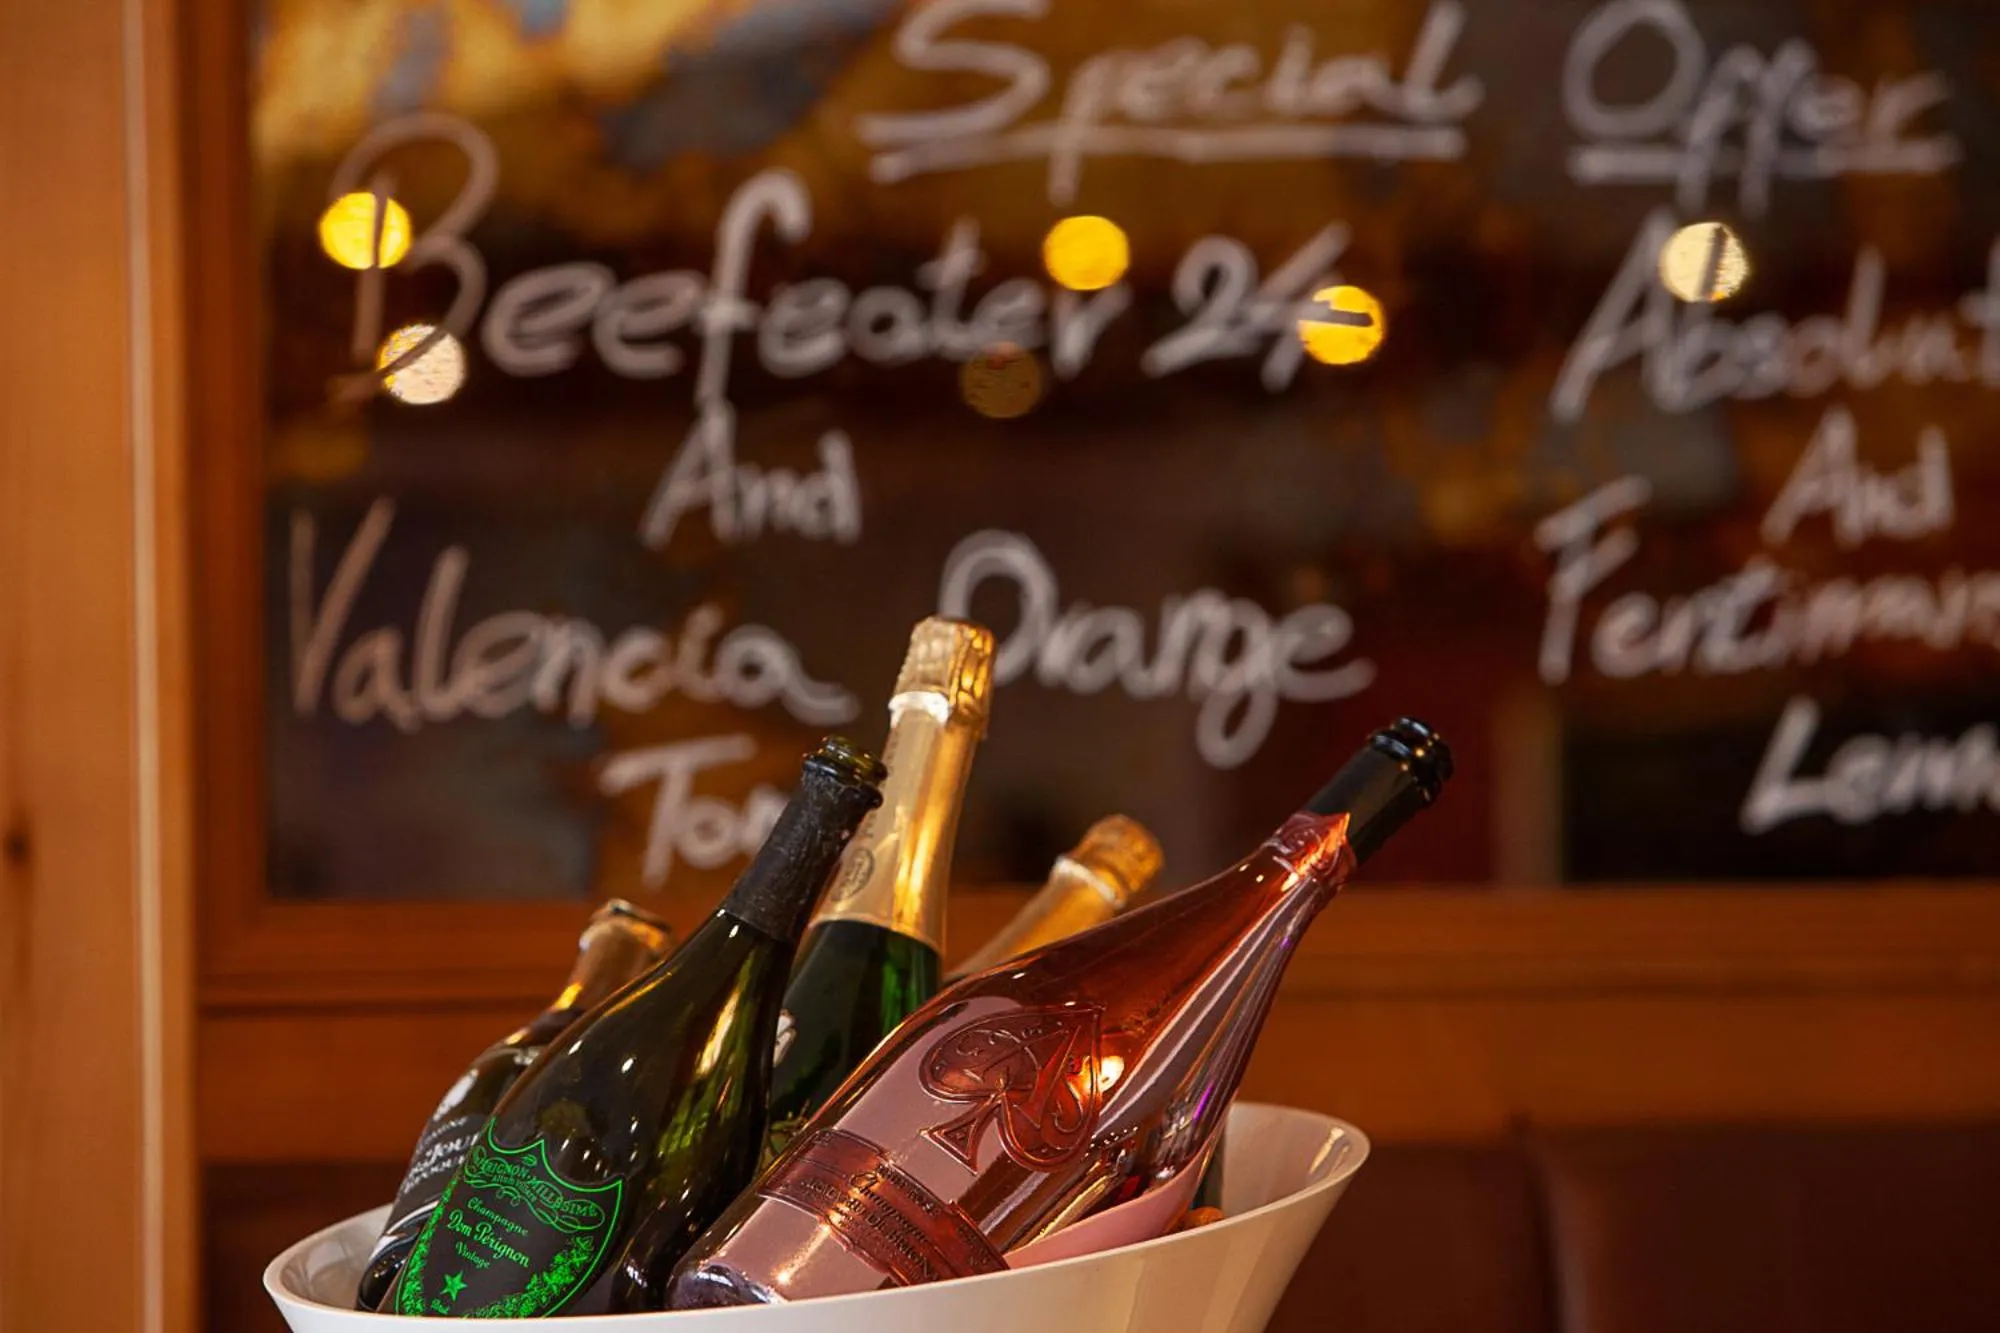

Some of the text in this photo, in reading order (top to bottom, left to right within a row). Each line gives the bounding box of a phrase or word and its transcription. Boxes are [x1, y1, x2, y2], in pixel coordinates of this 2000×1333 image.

[858, 0, 1950, 216] Special Offer
[328, 110, 1378, 412] Beefeater 24
[640, 400, 862, 547] And
[1760, 405, 1955, 545] And
[288, 498, 1378, 769] Valencia Orange
[448, 1207, 531, 1268] Dom Pérignon
[467, 1196, 530, 1238] Champagne
